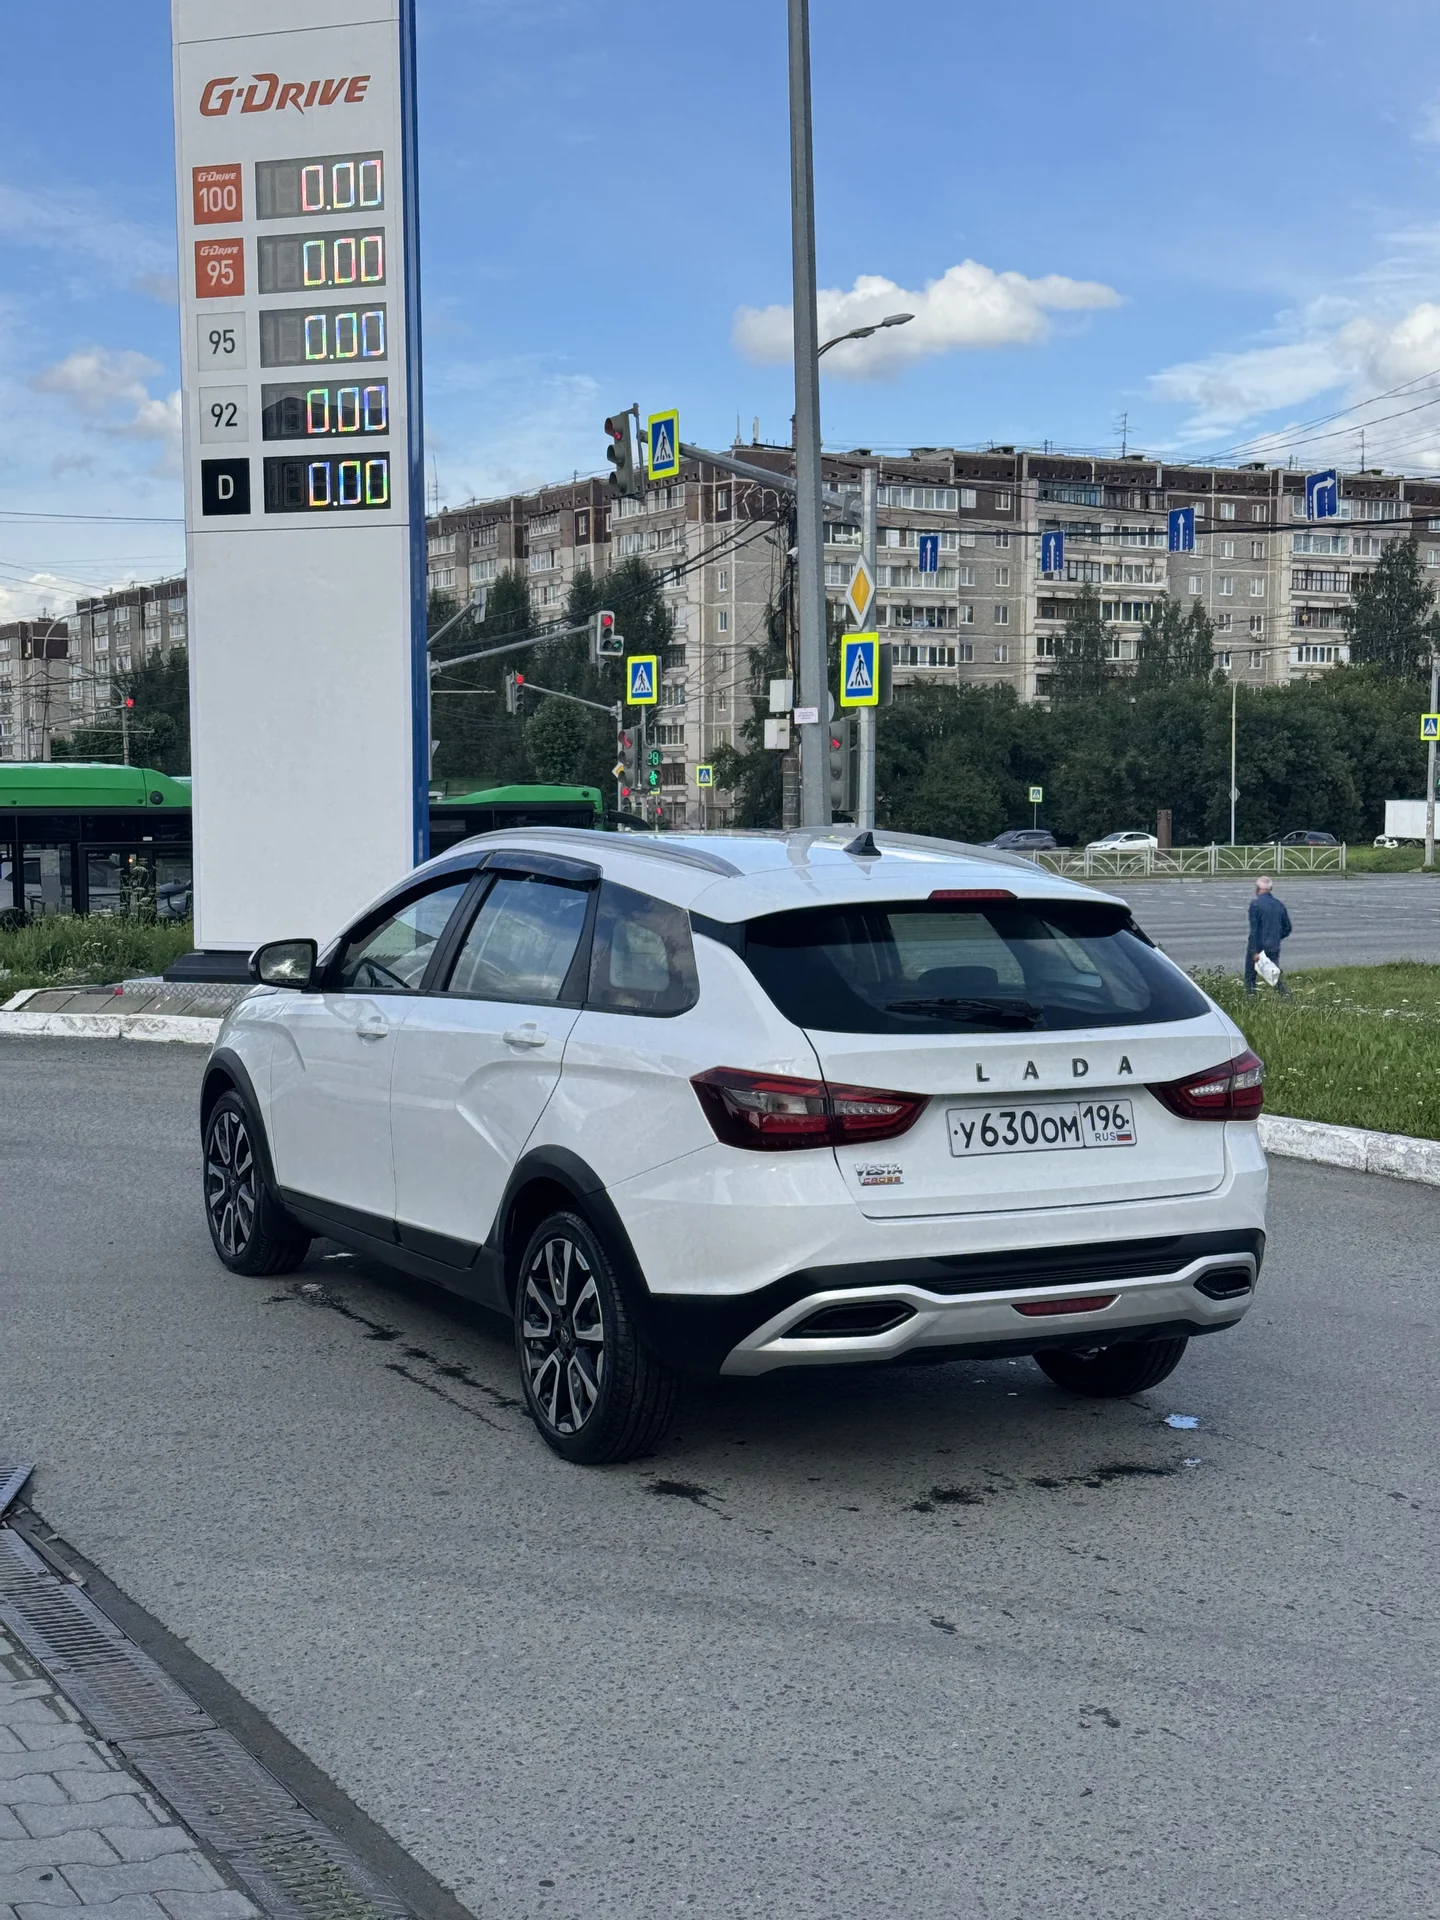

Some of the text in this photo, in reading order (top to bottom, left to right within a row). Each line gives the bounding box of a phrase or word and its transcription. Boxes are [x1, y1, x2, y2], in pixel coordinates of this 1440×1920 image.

[199, 185, 237, 213] 100
[301, 159, 382, 211] 0.00
[206, 259, 234, 286] 95
[303, 235, 383, 286] 0.00
[208, 328, 236, 355] 95
[304, 310, 385, 360] 0.00
[210, 402, 238, 428] 92
[306, 385, 387, 434] 0.00
[217, 474, 235, 500] D
[308, 459, 389, 506] 0.00
[975, 1055, 1133, 1083] LADA
[1082, 1104, 1126, 1132] 196
[1094, 1131, 1116, 1142] RUS
[854, 1163, 903, 1177] VESTA
